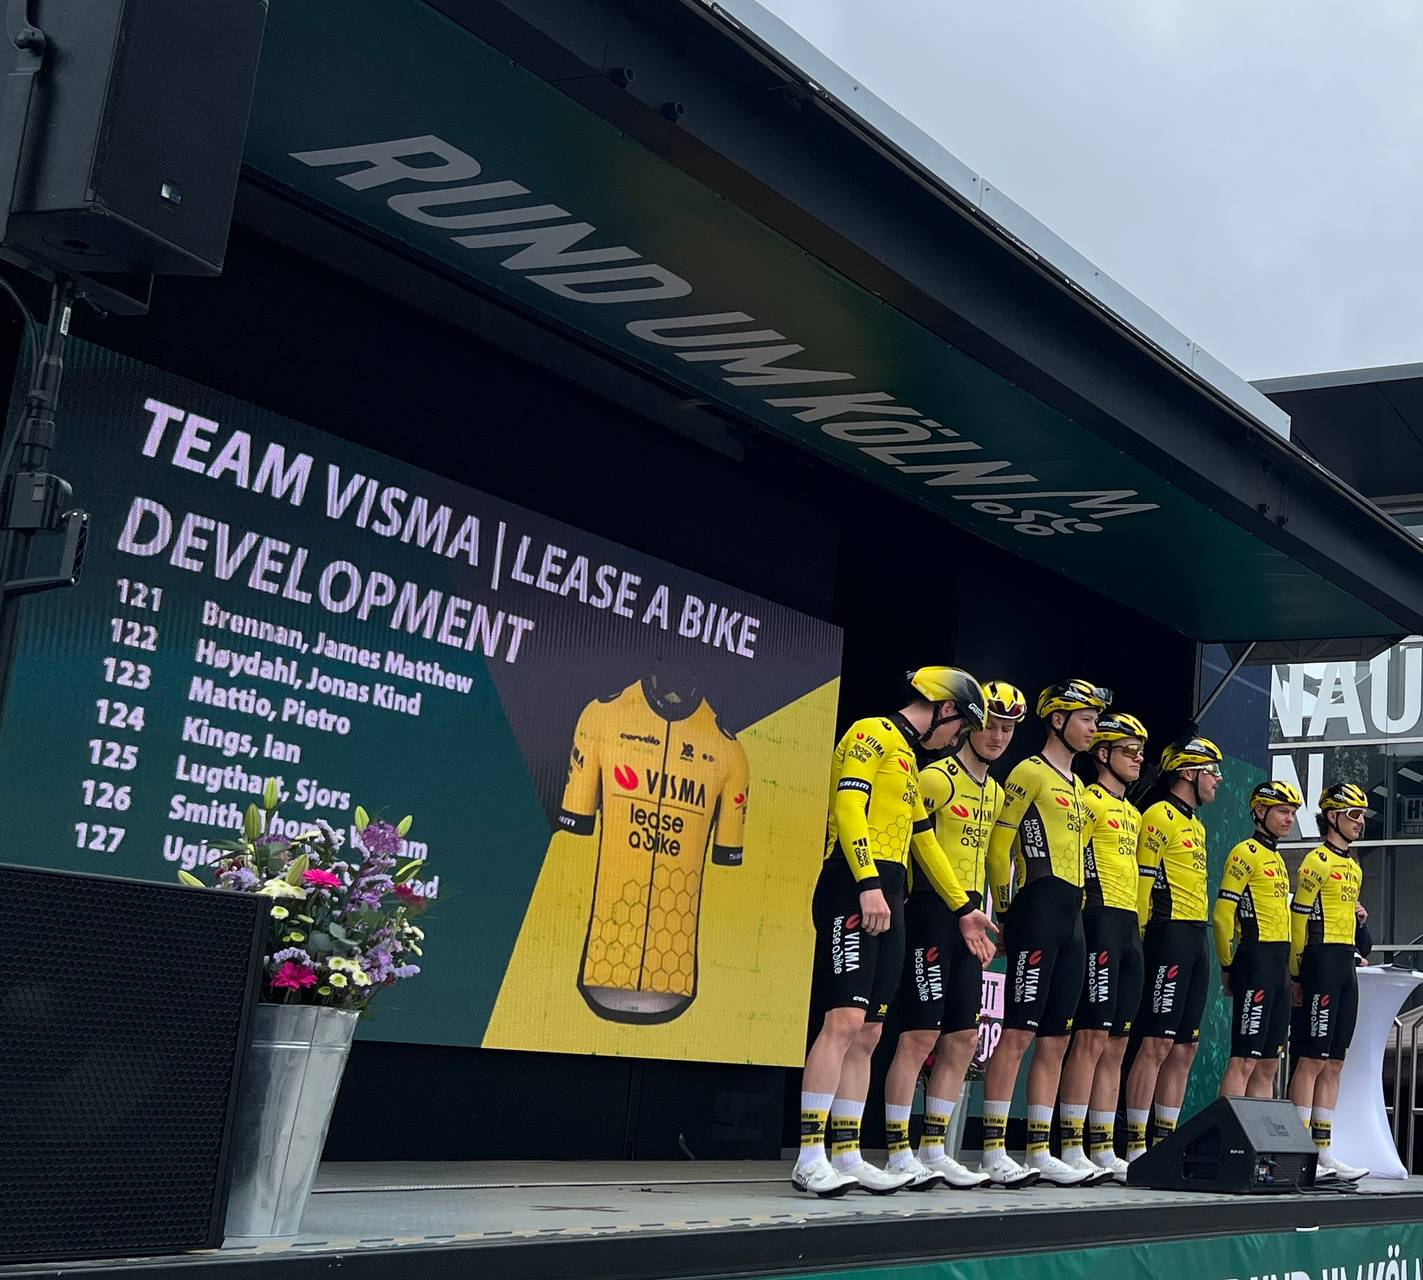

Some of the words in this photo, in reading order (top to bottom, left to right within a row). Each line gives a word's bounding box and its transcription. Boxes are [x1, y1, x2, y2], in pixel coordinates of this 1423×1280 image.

[288, 134, 692, 303] RUND
[626, 311, 857, 386] UM
[763, 391, 1039, 486] KÖLN
[141, 398, 314, 506] TEAM
[325, 463, 481, 567] VISMA
[511, 535, 642, 619] LEASE
[642, 585, 669, 630] A
[678, 594, 761, 659] BIKE
[117, 496, 536, 664] DEVELOPMENT
[116, 578, 163, 612] 121
[202, 600, 309, 655] Brennan,
[313, 632, 380, 670] James
[385, 651, 473, 694] Matthew
[111, 617, 159, 651] 122
[194, 638, 303, 690] Høydahl,
[306, 667, 369, 703] Jonas
[373, 683, 422, 717] Kind
[103, 657, 151, 690] 123
[188, 676, 277, 722] Mattio,
[282, 697, 351, 735] Pietro
[96, 699, 145, 731] 124
[182, 716, 258, 758] Kings,
[264, 733, 301, 764] Ian
[88, 739, 139, 771] 125
[294, 778, 351, 812] Sjors
[646, 768, 706, 809] VISMA
[82, 780, 131, 811] 126
[629, 802, 684, 833] lease
[1024, 819, 1035, 844] FOOD
[1031, 818, 1043, 847] COACH
[74, 822, 125, 853] 127
[832, 916, 845, 944] lease
[845, 932, 860, 972] VISMA
[914, 948, 924, 975] lease
[1016, 951, 1029, 977] lease
[928, 965, 943, 1000] VISMA
[1024, 967, 1040, 1002] VISMA
[1098, 967, 1109, 1002] VISMA
[1161, 981, 1177, 1013] VISMA
[1248, 1005, 1263, 1035] VISMA
[1318, 1008, 1330, 1038] VISMA
